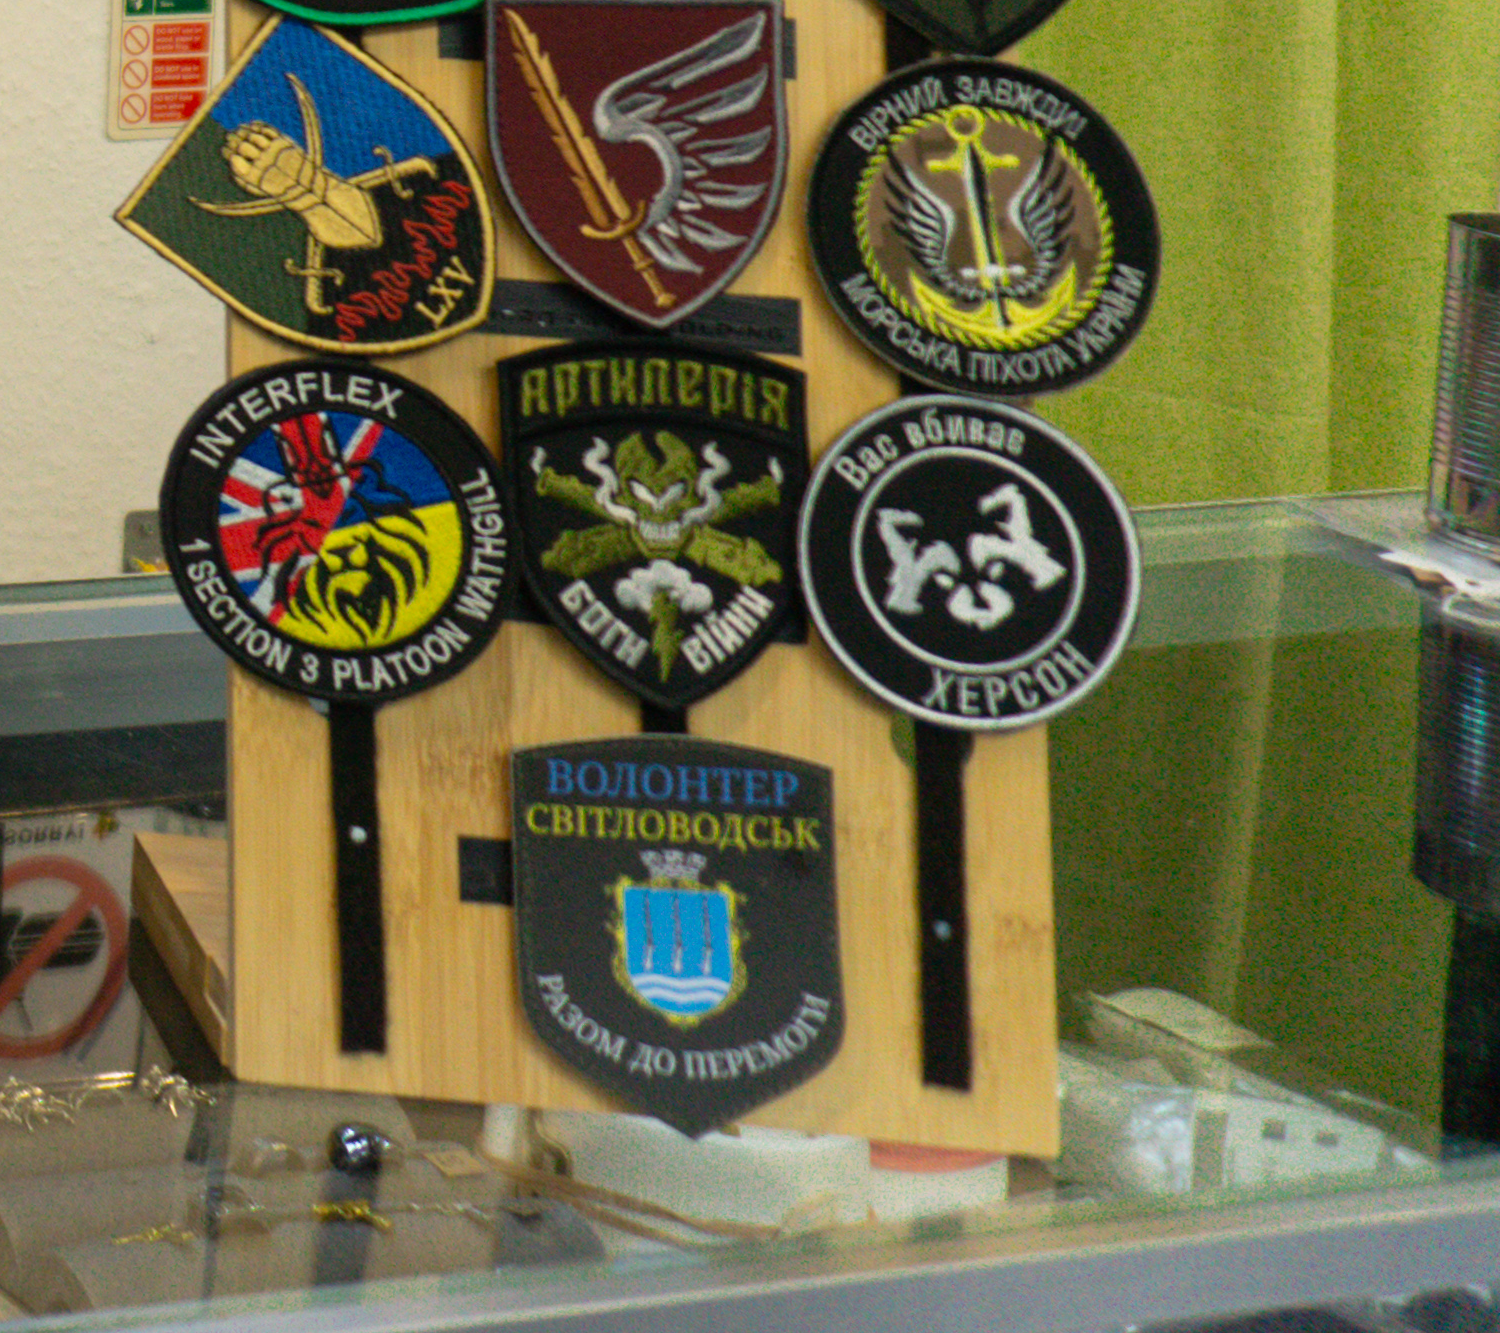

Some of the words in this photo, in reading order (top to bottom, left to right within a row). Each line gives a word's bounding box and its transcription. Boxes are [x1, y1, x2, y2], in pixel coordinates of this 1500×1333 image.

[848, 75, 948, 152] ВІРНИЙ
[954, 75, 1089, 141] ЗАВЖДИ
[839, 272, 962, 376] МОРСЬКА
[966, 343, 1078, 384] ПІХОТА
[1064, 262, 1147, 365] УКРАЇНИ
[189, 370, 403, 469] INTERFLEX
[833, 433, 899, 491] Вас
[178, 537, 212, 553] 1
[455, 466, 508, 622] WATHGILL
[186, 559, 293, 674] SECTION
[330, 617, 472, 691] PLATOON
[679, 584, 775, 675] ВІЙНИ
[299, 654, 320, 684] 3
[921, 638, 1098, 717] ХЕРСОН
[546, 757, 800, 808] ВОЛОНТЕР
[525, 802, 823, 853] СВІТЛОВОДСЬК
[535, 973, 628, 1063] РАЗОМ
[628, 1041, 677, 1078] ДО
[682, 991, 831, 1080] ПЕРЕМОГИ
